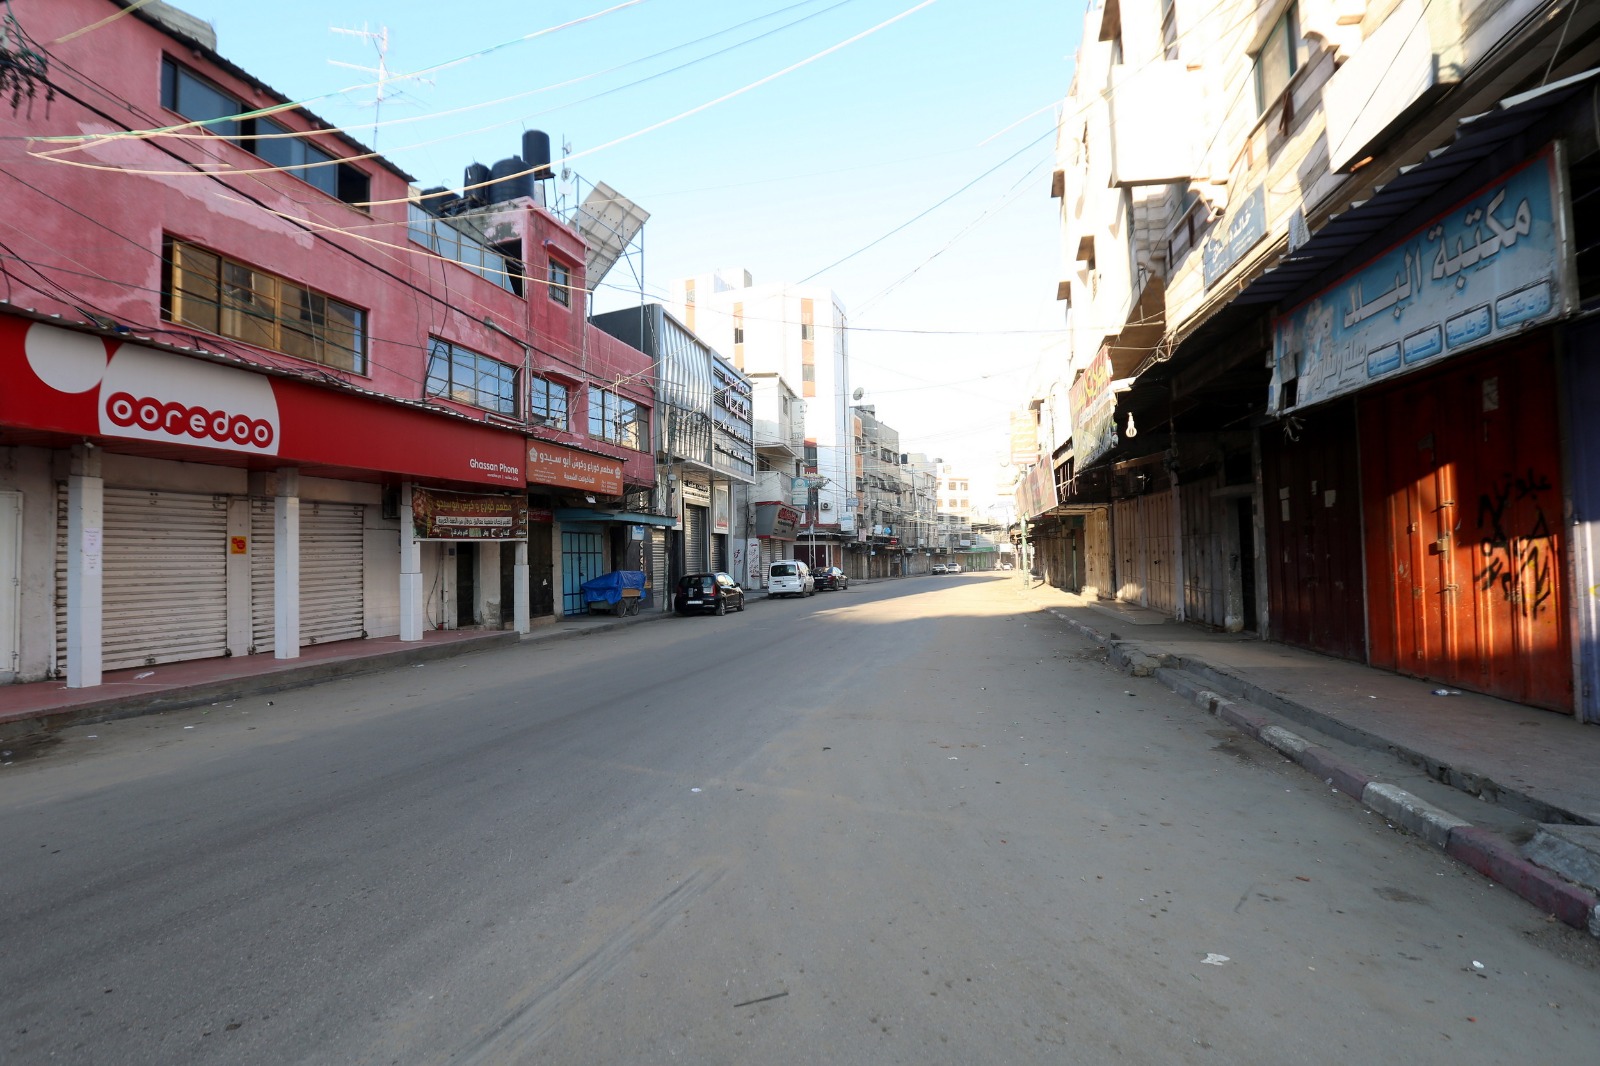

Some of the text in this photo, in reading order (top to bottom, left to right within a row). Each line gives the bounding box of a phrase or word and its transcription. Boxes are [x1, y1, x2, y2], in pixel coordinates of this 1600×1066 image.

[1344, 185, 1532, 329] مكتبة البلد
[110, 396, 270, 445] ooredoo
[469, 457, 498, 472] Ghassan
[499, 462, 519, 475] Phone
[539, 451, 561, 465] سيدو
[599, 464, 614, 475] مطعم
[495, 502, 512, 513] مطعم
